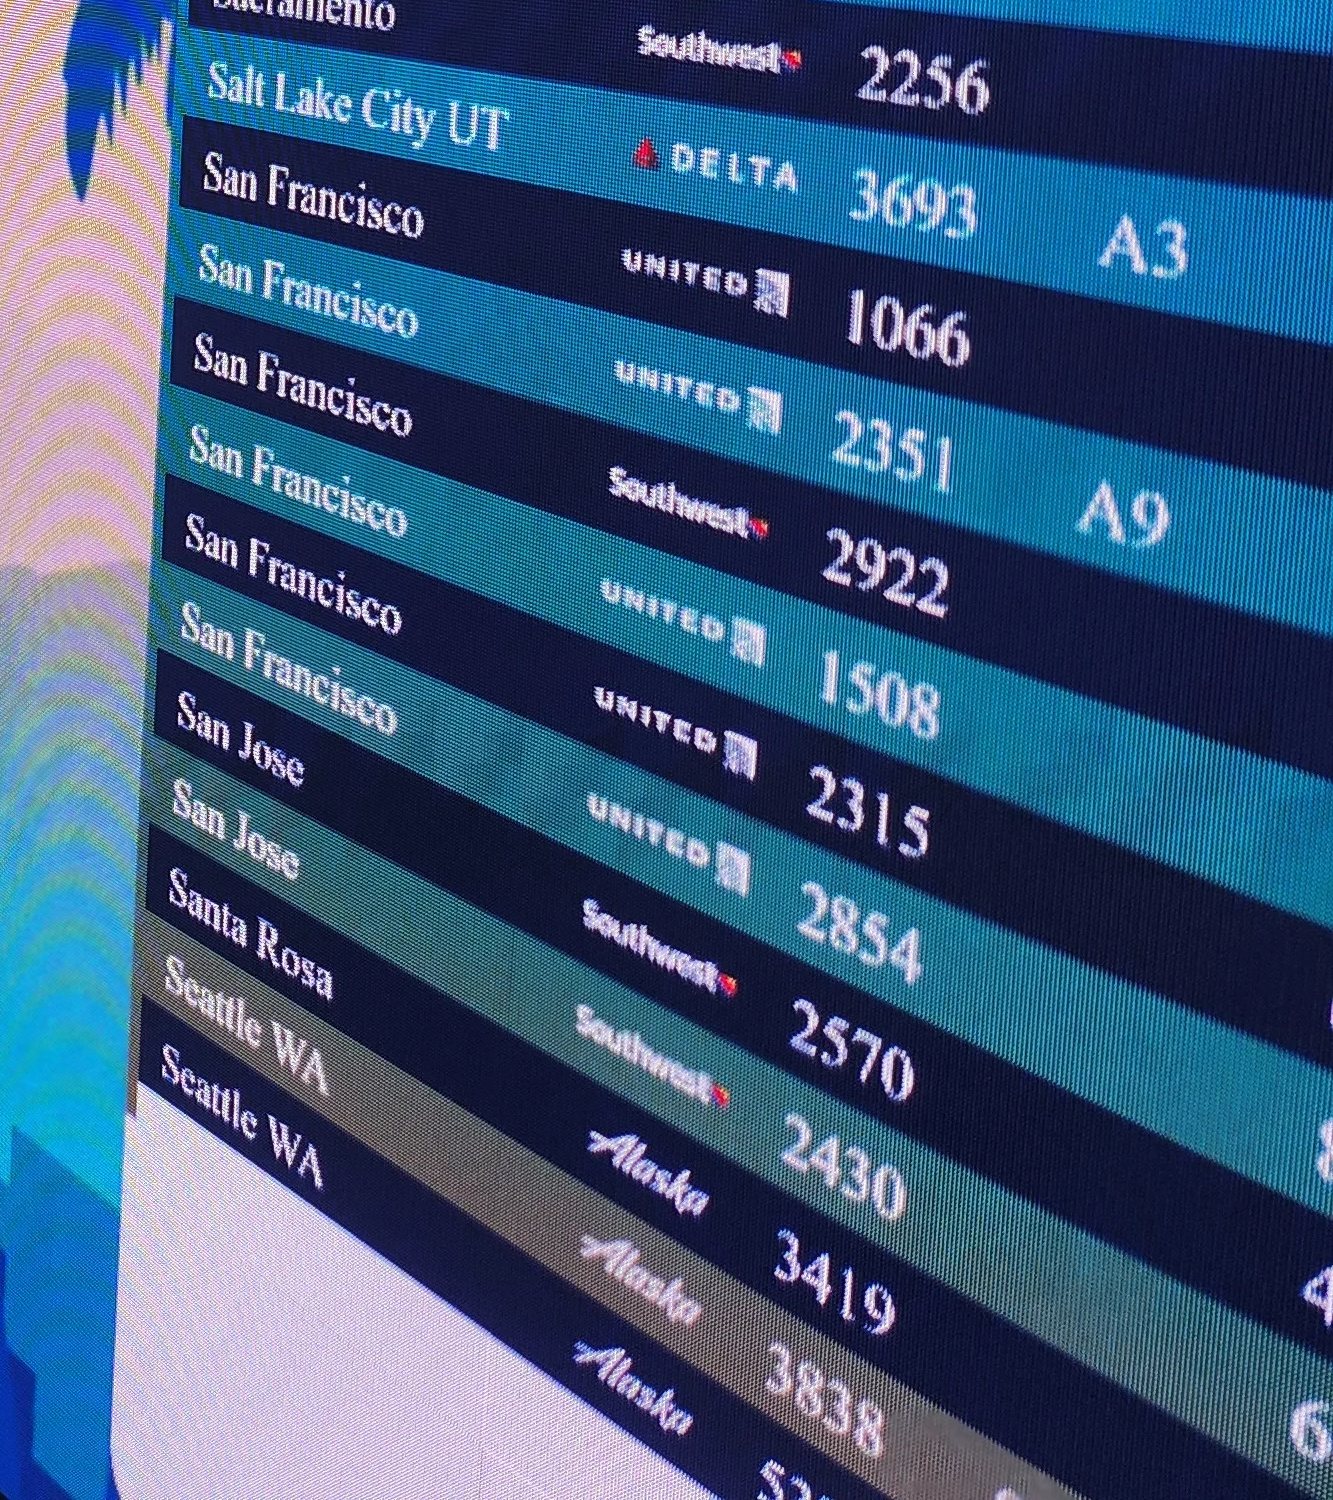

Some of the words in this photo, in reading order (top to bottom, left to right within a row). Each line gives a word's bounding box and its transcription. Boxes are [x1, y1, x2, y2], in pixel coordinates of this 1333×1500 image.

[207, 60, 265, 108] Salt
[275, 70, 353, 124] Lake
[362, 87, 436, 150] City
[449, 100, 511, 152] UT
[670, 141, 798, 194] DELTA
[848, 168, 978, 240] 3693
[1097, 213, 1189, 280] A3
[636, 24, 783, 77] Southwest
[854, 44, 991, 116] 2256
[198, 242, 253, 294] San
[262, 258, 419, 339] Francisco
[613, 359, 742, 413] UNITED
[833, 409, 951, 494] 2351
[1075, 477, 1170, 549] A9
[203, 151, 258, 202] San
[267, 163, 425, 239] Francisco
[620, 248, 748, 297] UNITED
[847, 289, 970, 368] 1066
[189, 423, 243, 479] San
[252, 444, 409, 538] Francisco
[600, 578, 726, 643] UNITED
[823, 649, 941, 741] 1508
[193, 332, 248, 386] San
[256, 350, 413, 438] Francisco
[608, 465, 751, 540] Southwest
[821, 527, 949, 620] 2922
[181, 601, 234, 661] San
[243, 627, 398, 736] Francisco
[587, 791, 711, 868] UNITED
[796, 880, 922, 986] 2854
[184, 512, 238, 569] San
[248, 537, 403, 636] Francisco
[593, 685, 717, 754] UNITED
[806, 764, 930, 860] 2315
[172, 778, 226, 841] San
[233, 810, 301, 881] Jose
[575, 1003, 713, 1106] Southwest
[783, 1112, 909, 1223] 2430
[177, 690, 230, 751] San
[237, 720, 306, 788] Jose
[582, 898, 718, 994] Southwest
[789, 998, 915, 1103] 2570
[161, 1042, 258, 1141] Seattle
[266, 1113, 323, 1190] WA
[573, 1340, 694, 1437] Alaska
[164, 955, 262, 1050] Seattle
[271, 1020, 330, 1097] WA
[765, 1340, 883, 1457] 3838
[169, 867, 248, 949] Santa
[257, 916, 333, 1001] Rosa
[586, 1129, 710, 1218] Alaska
[774, 1228, 897, 1337] 3419
